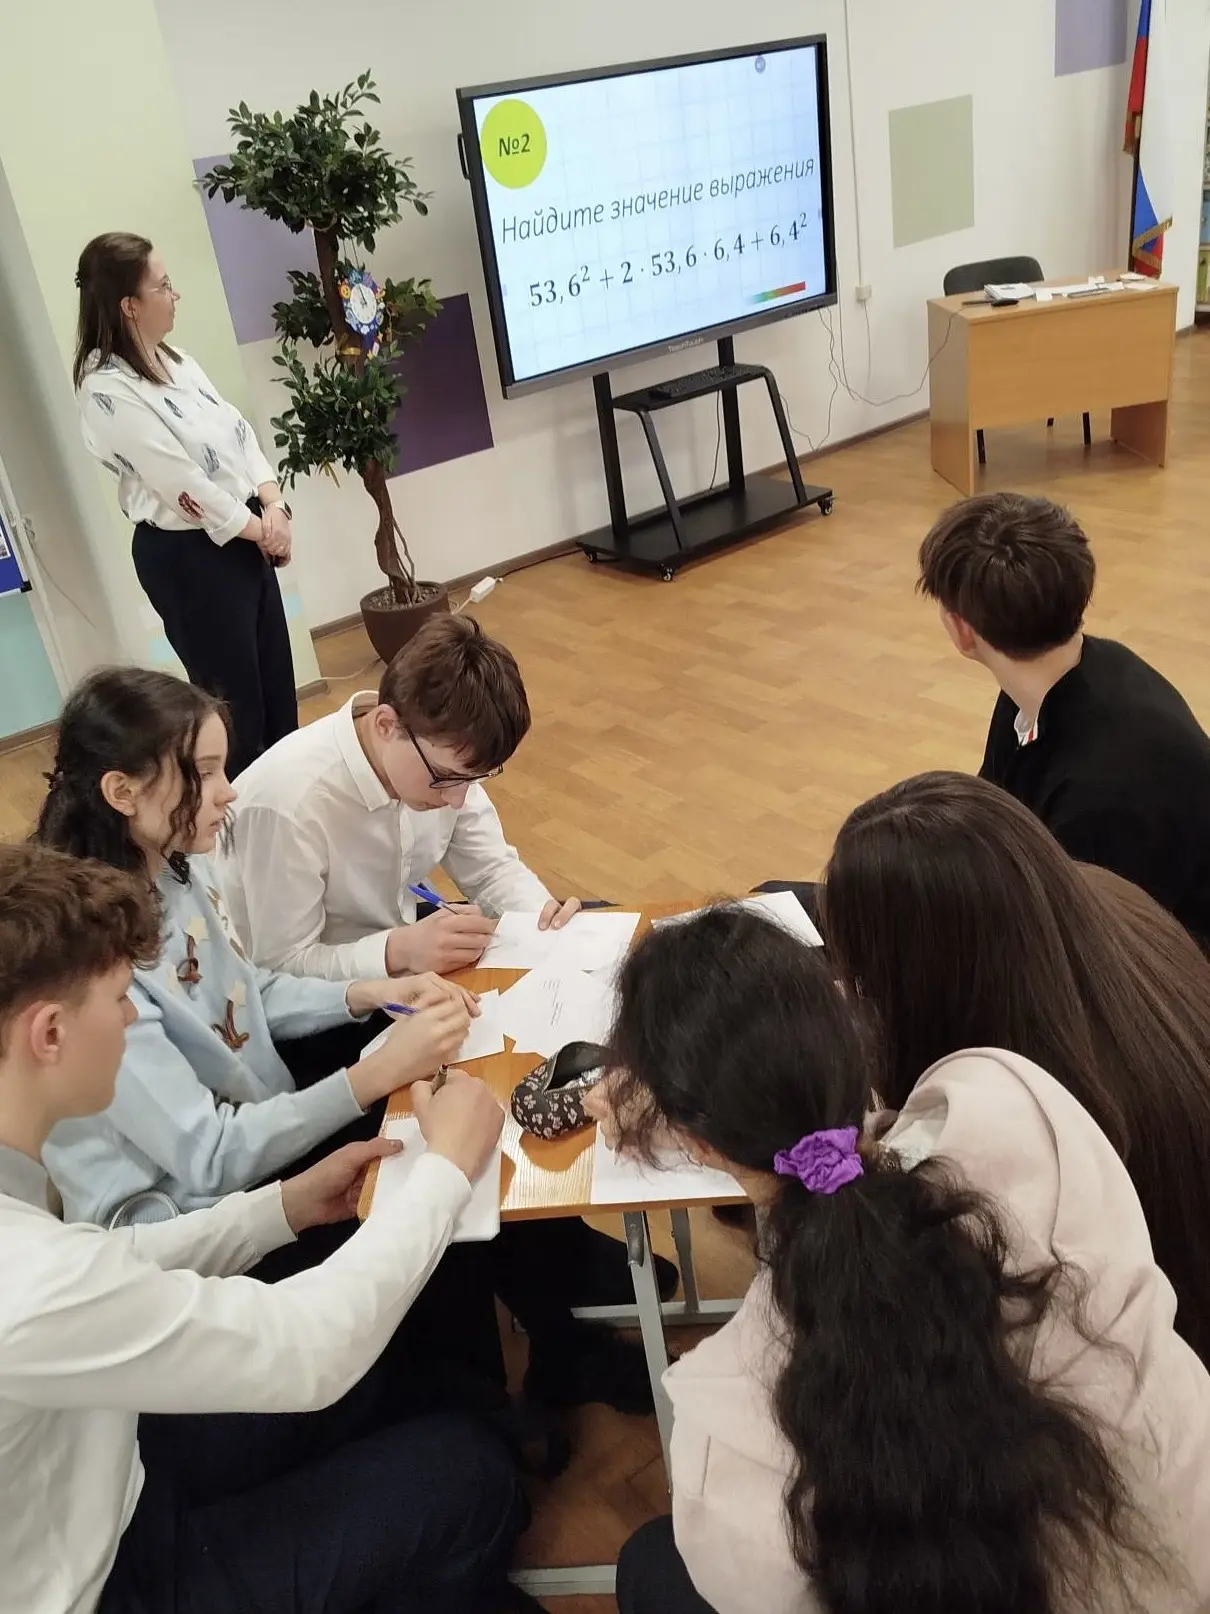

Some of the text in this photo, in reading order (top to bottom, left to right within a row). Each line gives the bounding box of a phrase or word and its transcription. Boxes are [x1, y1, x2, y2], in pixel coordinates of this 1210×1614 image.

[499, 133, 531, 157] №2
[502, 158, 815, 244] Найдите значение выражения
